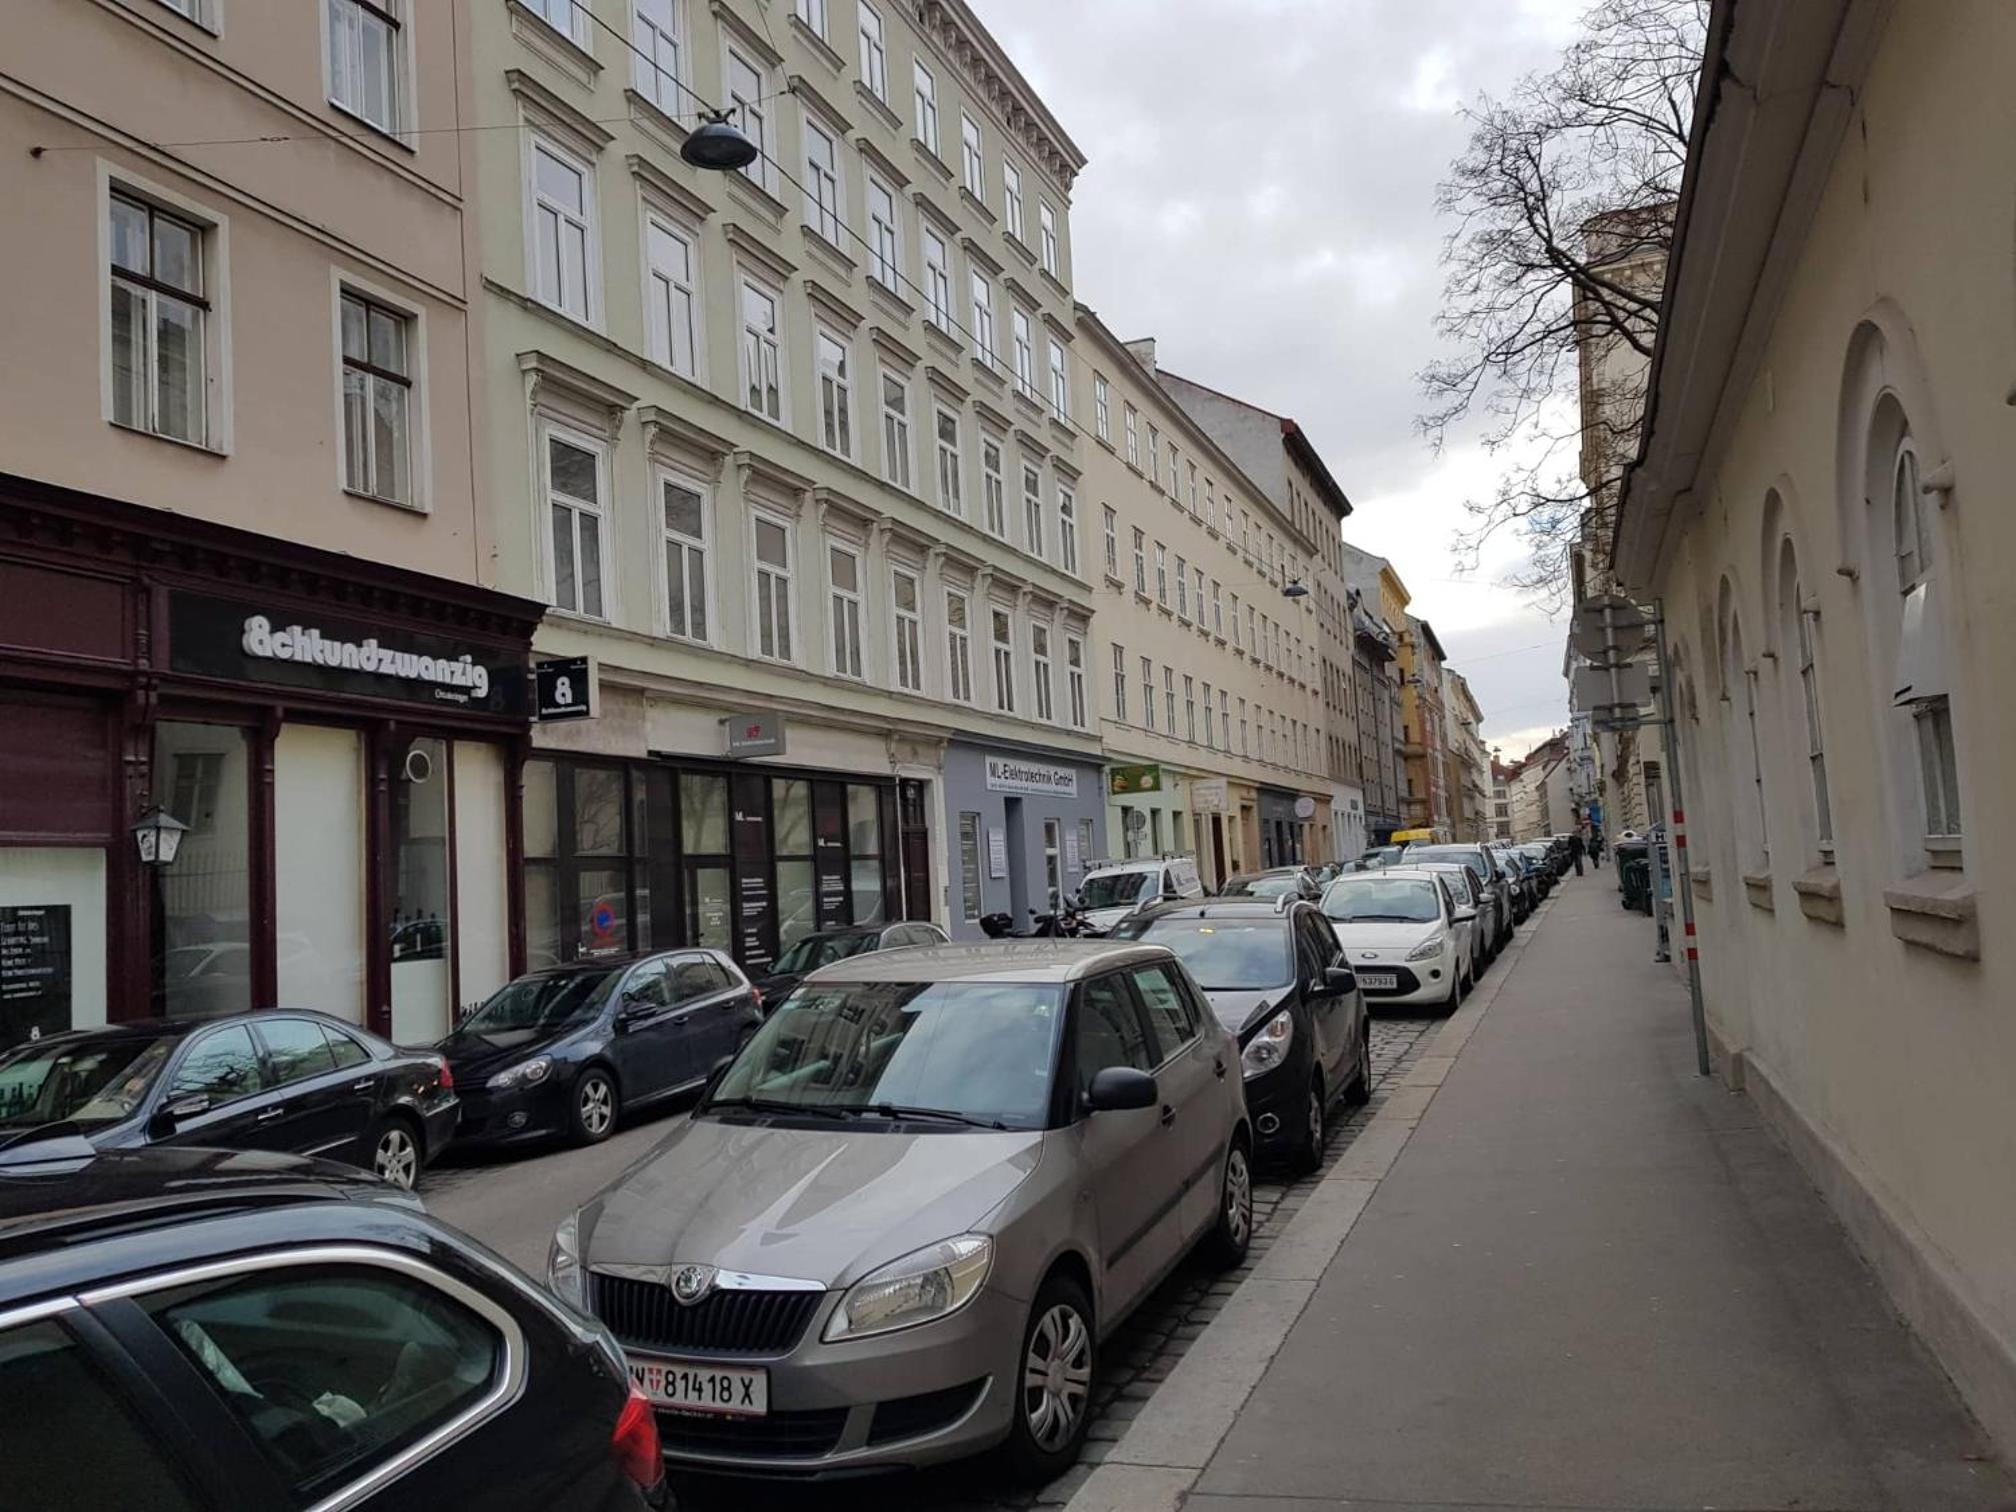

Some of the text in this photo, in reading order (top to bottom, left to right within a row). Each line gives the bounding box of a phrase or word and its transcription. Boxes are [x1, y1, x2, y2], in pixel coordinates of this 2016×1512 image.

[1053, 770, 1074, 787] GmbH
[664, 1370, 732, 1404] 81418
[740, 1376, 755, 1406] X
